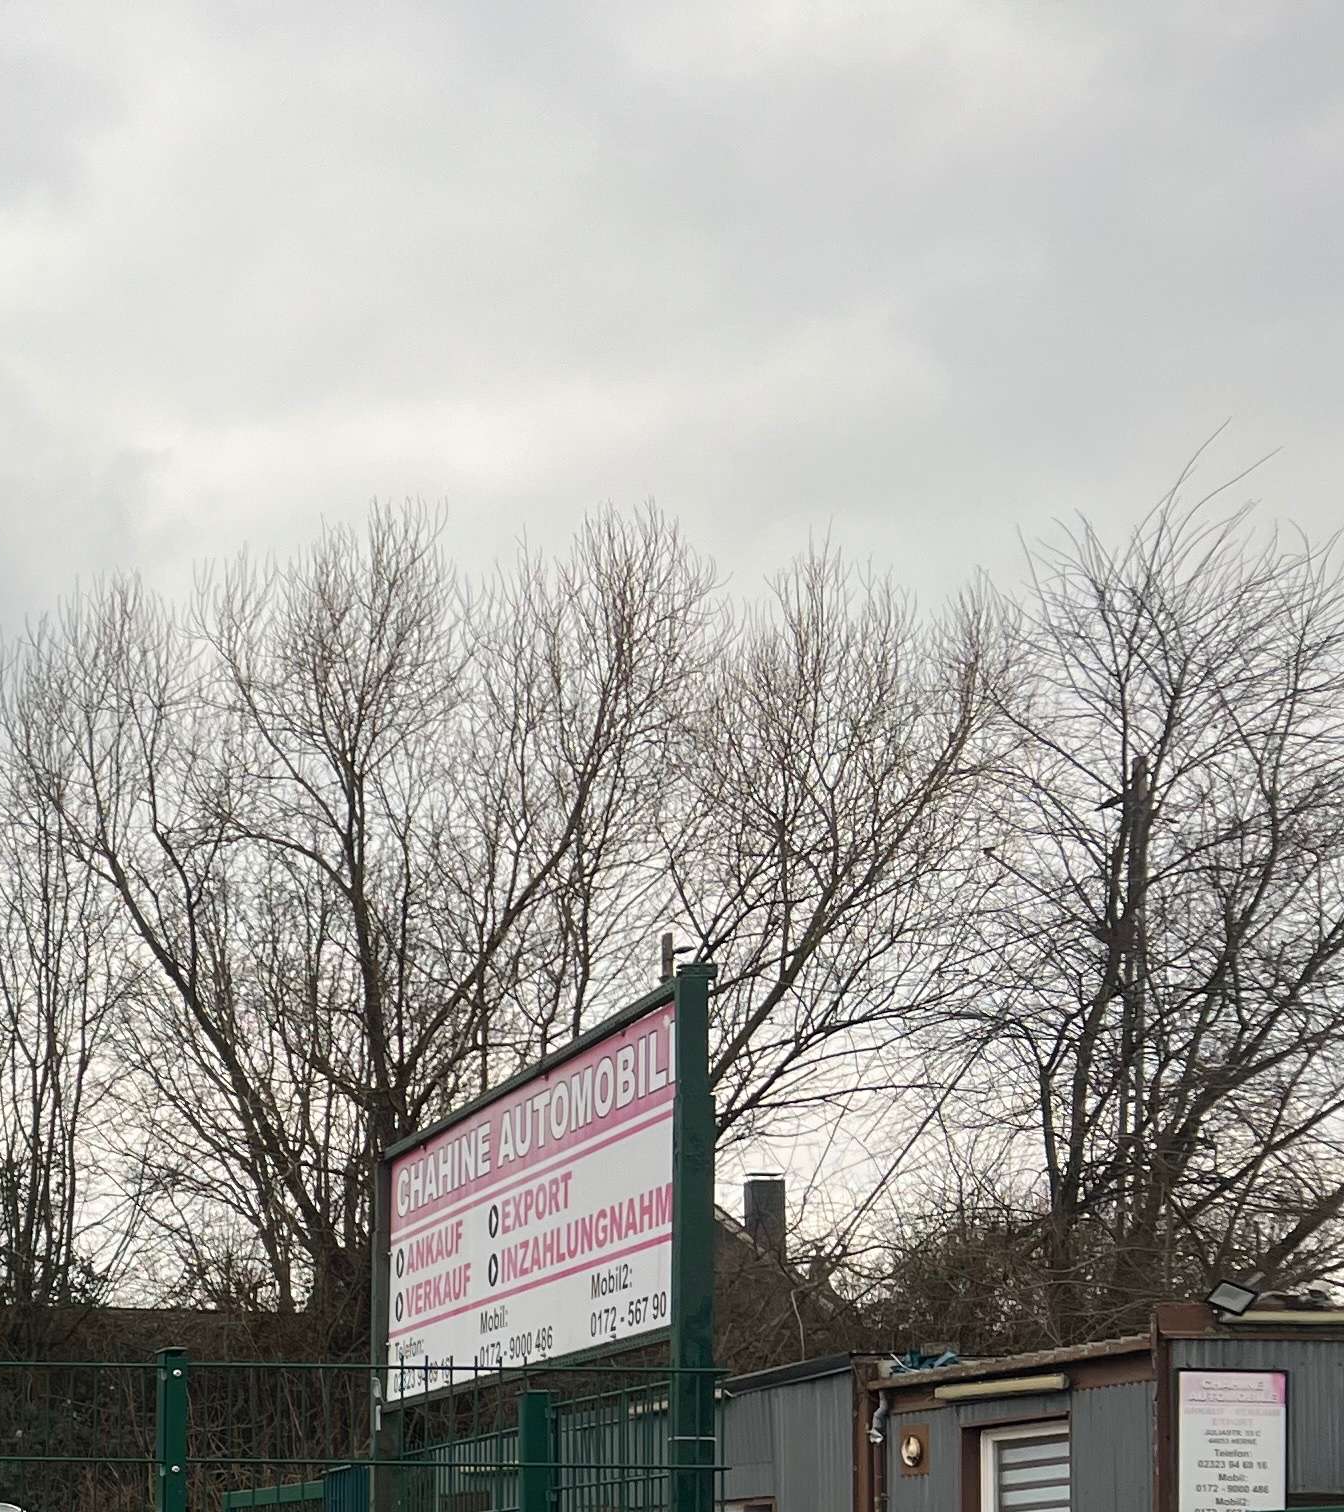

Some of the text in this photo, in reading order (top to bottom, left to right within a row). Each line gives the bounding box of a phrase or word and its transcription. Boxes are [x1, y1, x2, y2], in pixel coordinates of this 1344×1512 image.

[397, 1120, 492, 1217] CHAHINE
[501, 1171, 572, 1234] EXPORT
[406, 1220, 463, 1276] ANKAUF
[406, 1263, 472, 1317] VERKAUF
[590, 1264, 633, 1300] Mobil2:
[480, 1306, 509, 1334] Mobil:
[590, 1306, 617, 1338] 0172
[628, 1296, 649, 1327] 567
[653, 1291, 667, 1320] 90
[395, 1337, 425, 1362] Telefon:
[479, 1341, 502, 1368] 0172
[509, 1331, 532, 1360] 9000
[535, 1325, 553, 1351] 486
[1195, 1484, 1219, 1493] 0172
